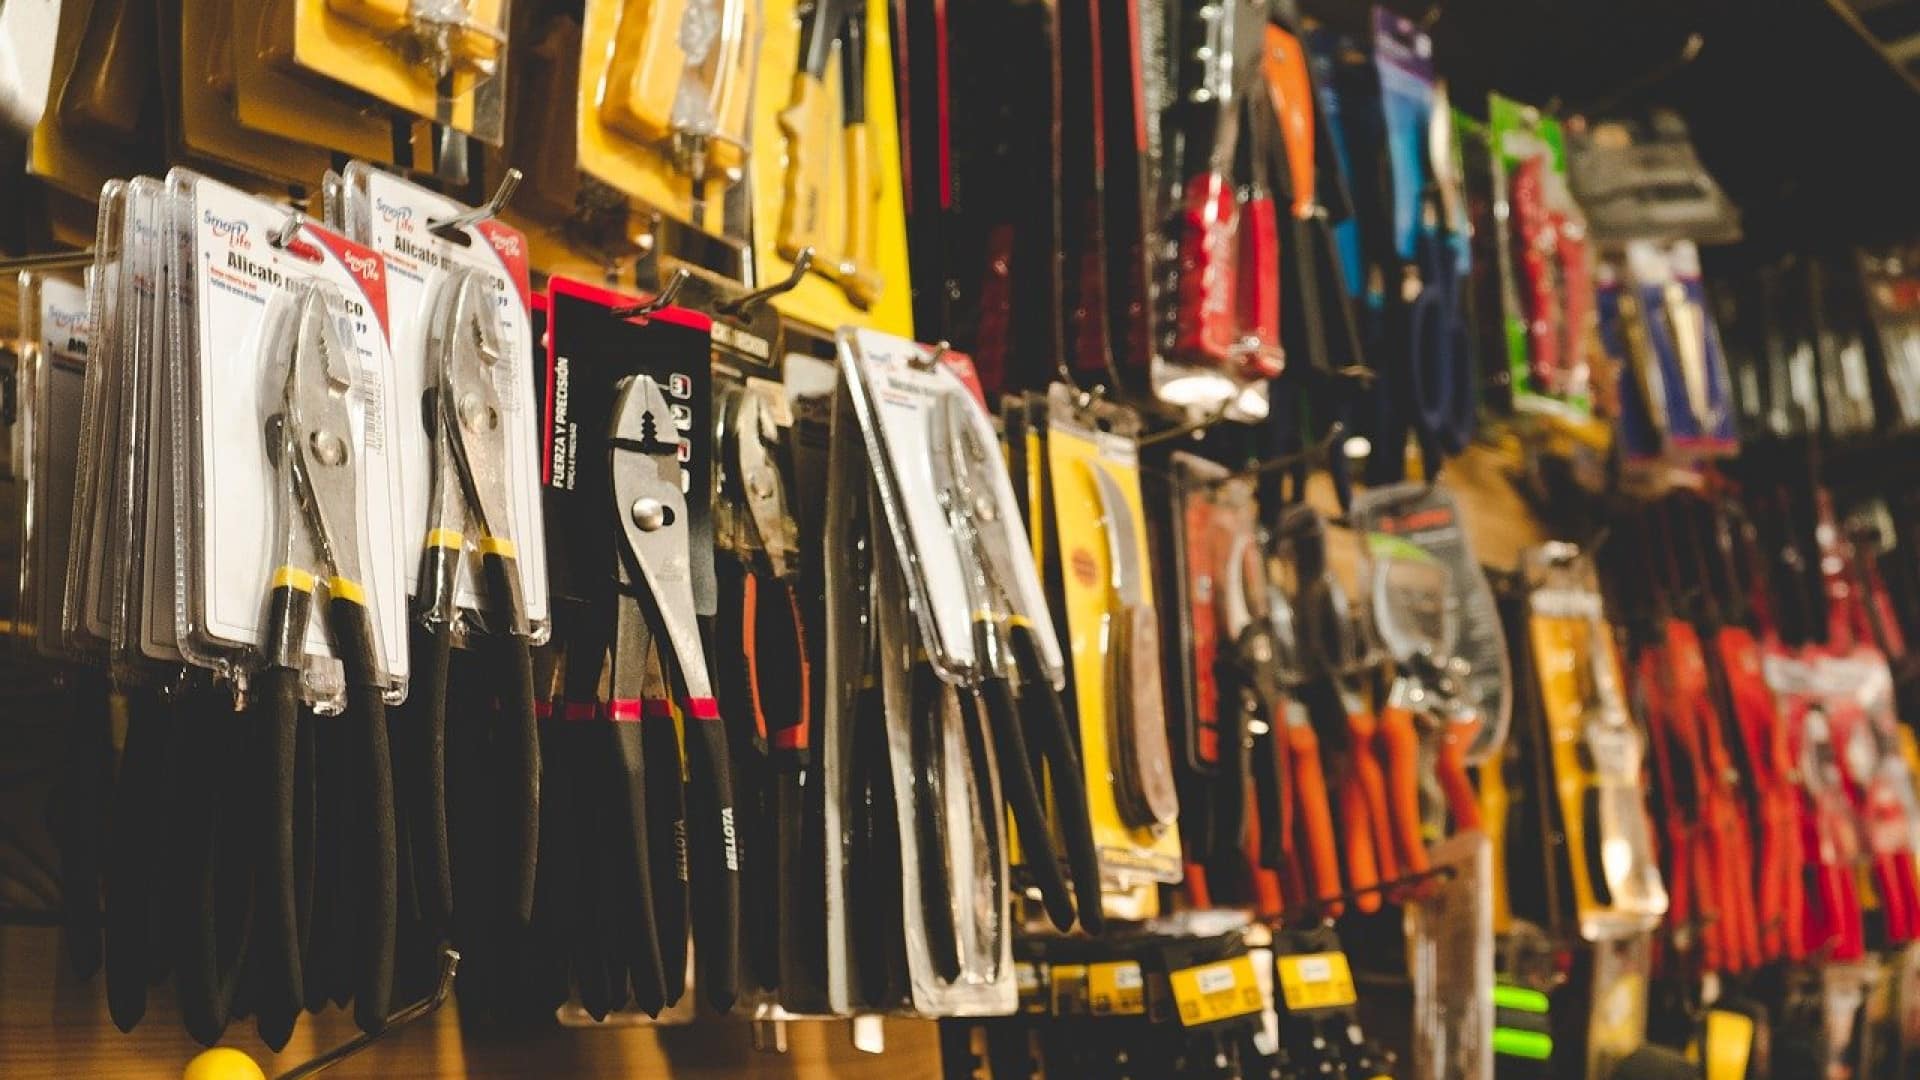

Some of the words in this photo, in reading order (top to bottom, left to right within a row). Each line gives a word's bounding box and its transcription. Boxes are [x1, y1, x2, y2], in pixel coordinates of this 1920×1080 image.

[227, 251, 282, 288] Alicate
[394, 235, 439, 267] Alicate
[555, 356, 569, 424] PRECISIÓN
[555, 423, 567, 435] Y
[552, 437, 567, 489] FUERZA
[674, 819, 688, 881] BELLOTA
[722, 806, 738, 871] BELLOTA
